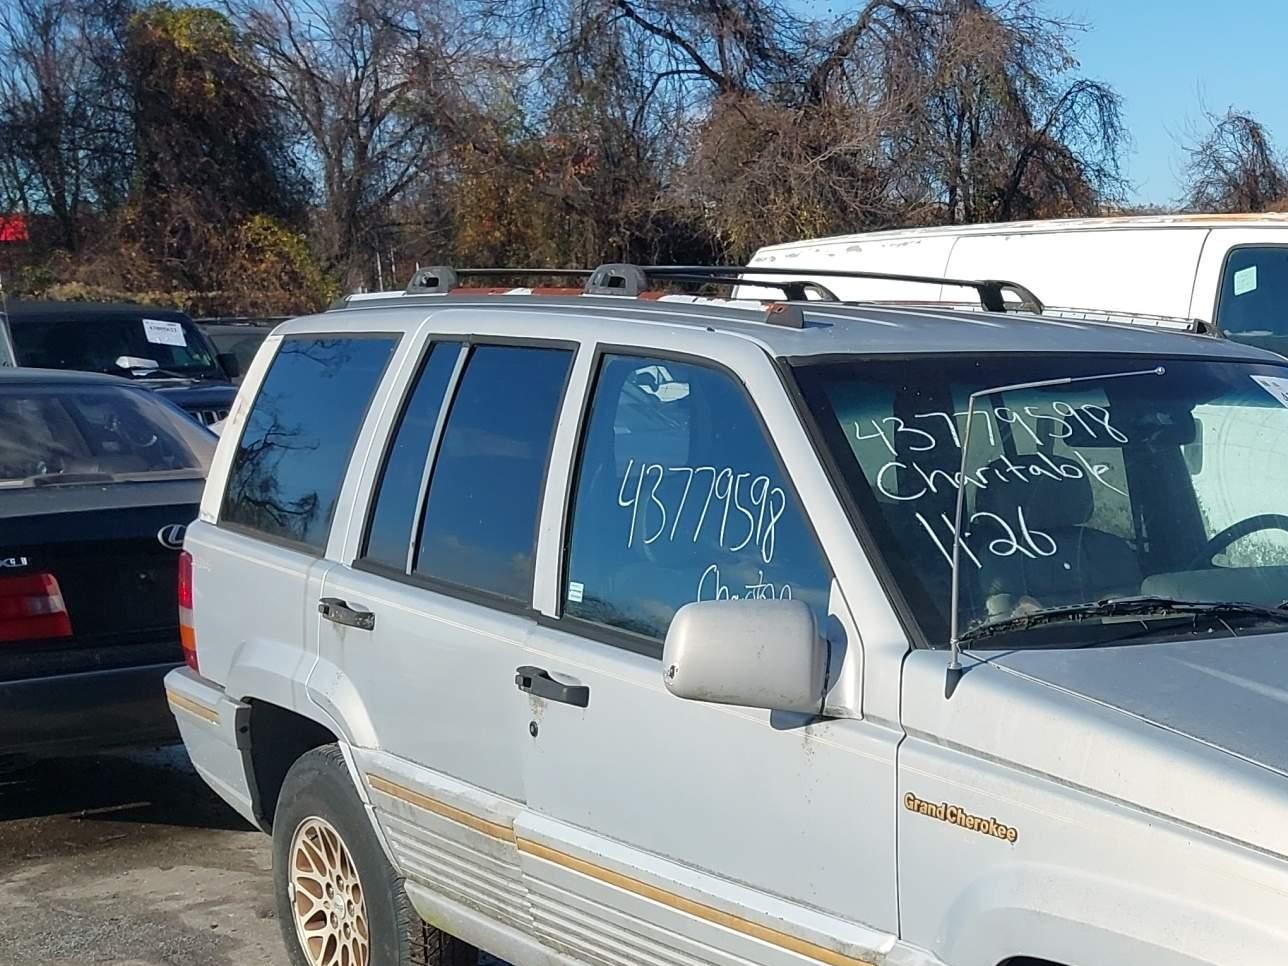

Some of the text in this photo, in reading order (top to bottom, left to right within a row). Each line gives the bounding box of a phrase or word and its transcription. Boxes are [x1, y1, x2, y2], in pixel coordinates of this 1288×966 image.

[853, 400, 1129, 457] 43779598
[876, 449, 1130, 501] Charitable
[617, 458, 786, 564] 43779598
[904, 792, 1018, 843] Grand Cherokee
